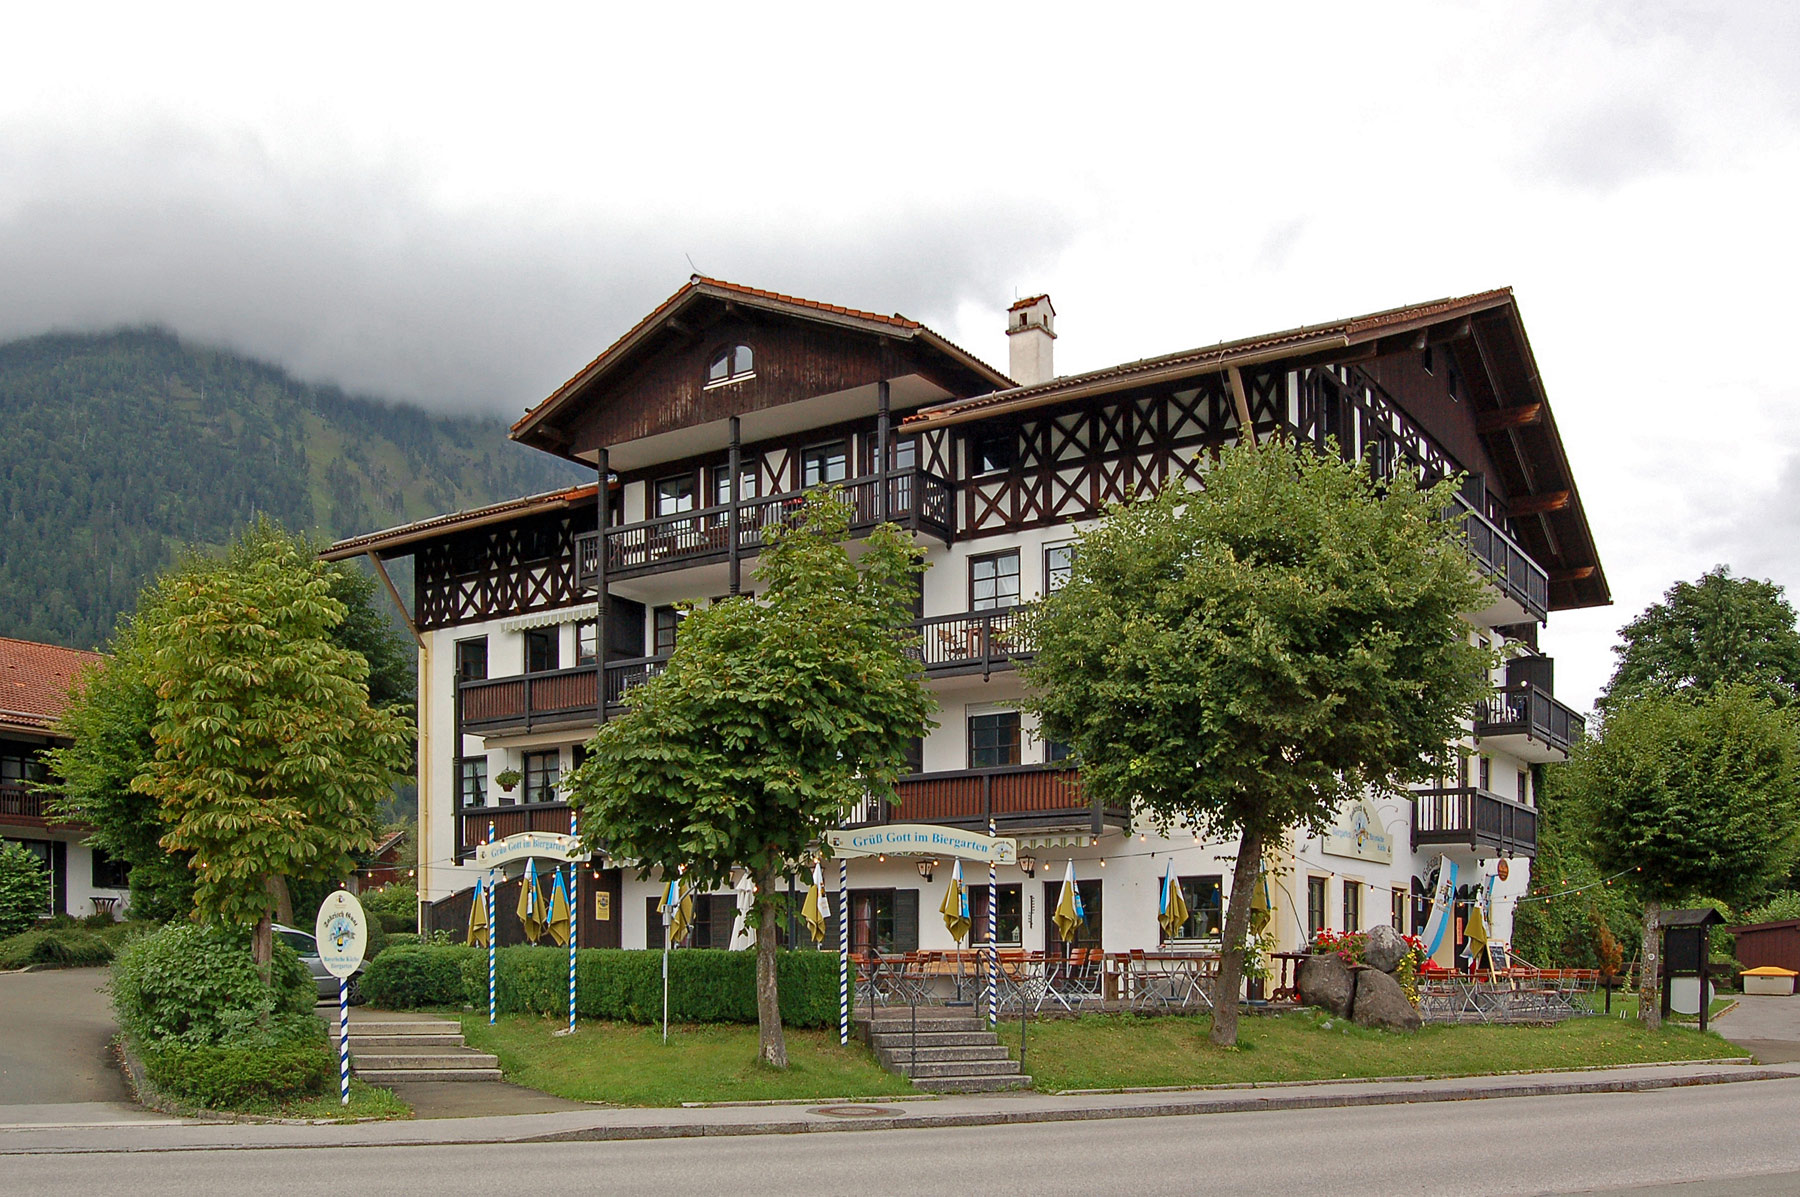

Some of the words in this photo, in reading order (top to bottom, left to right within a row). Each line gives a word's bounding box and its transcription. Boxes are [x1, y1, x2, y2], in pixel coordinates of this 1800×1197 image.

[508, 841, 522, 852] Gott
[523, 839, 531, 849] im
[533, 839, 566, 852] Biergarten
[853, 833, 883, 847] Grüß
[886, 831, 912, 843] Gott
[914, 831, 929, 843] im
[932, 833, 988, 853] Biergarten
